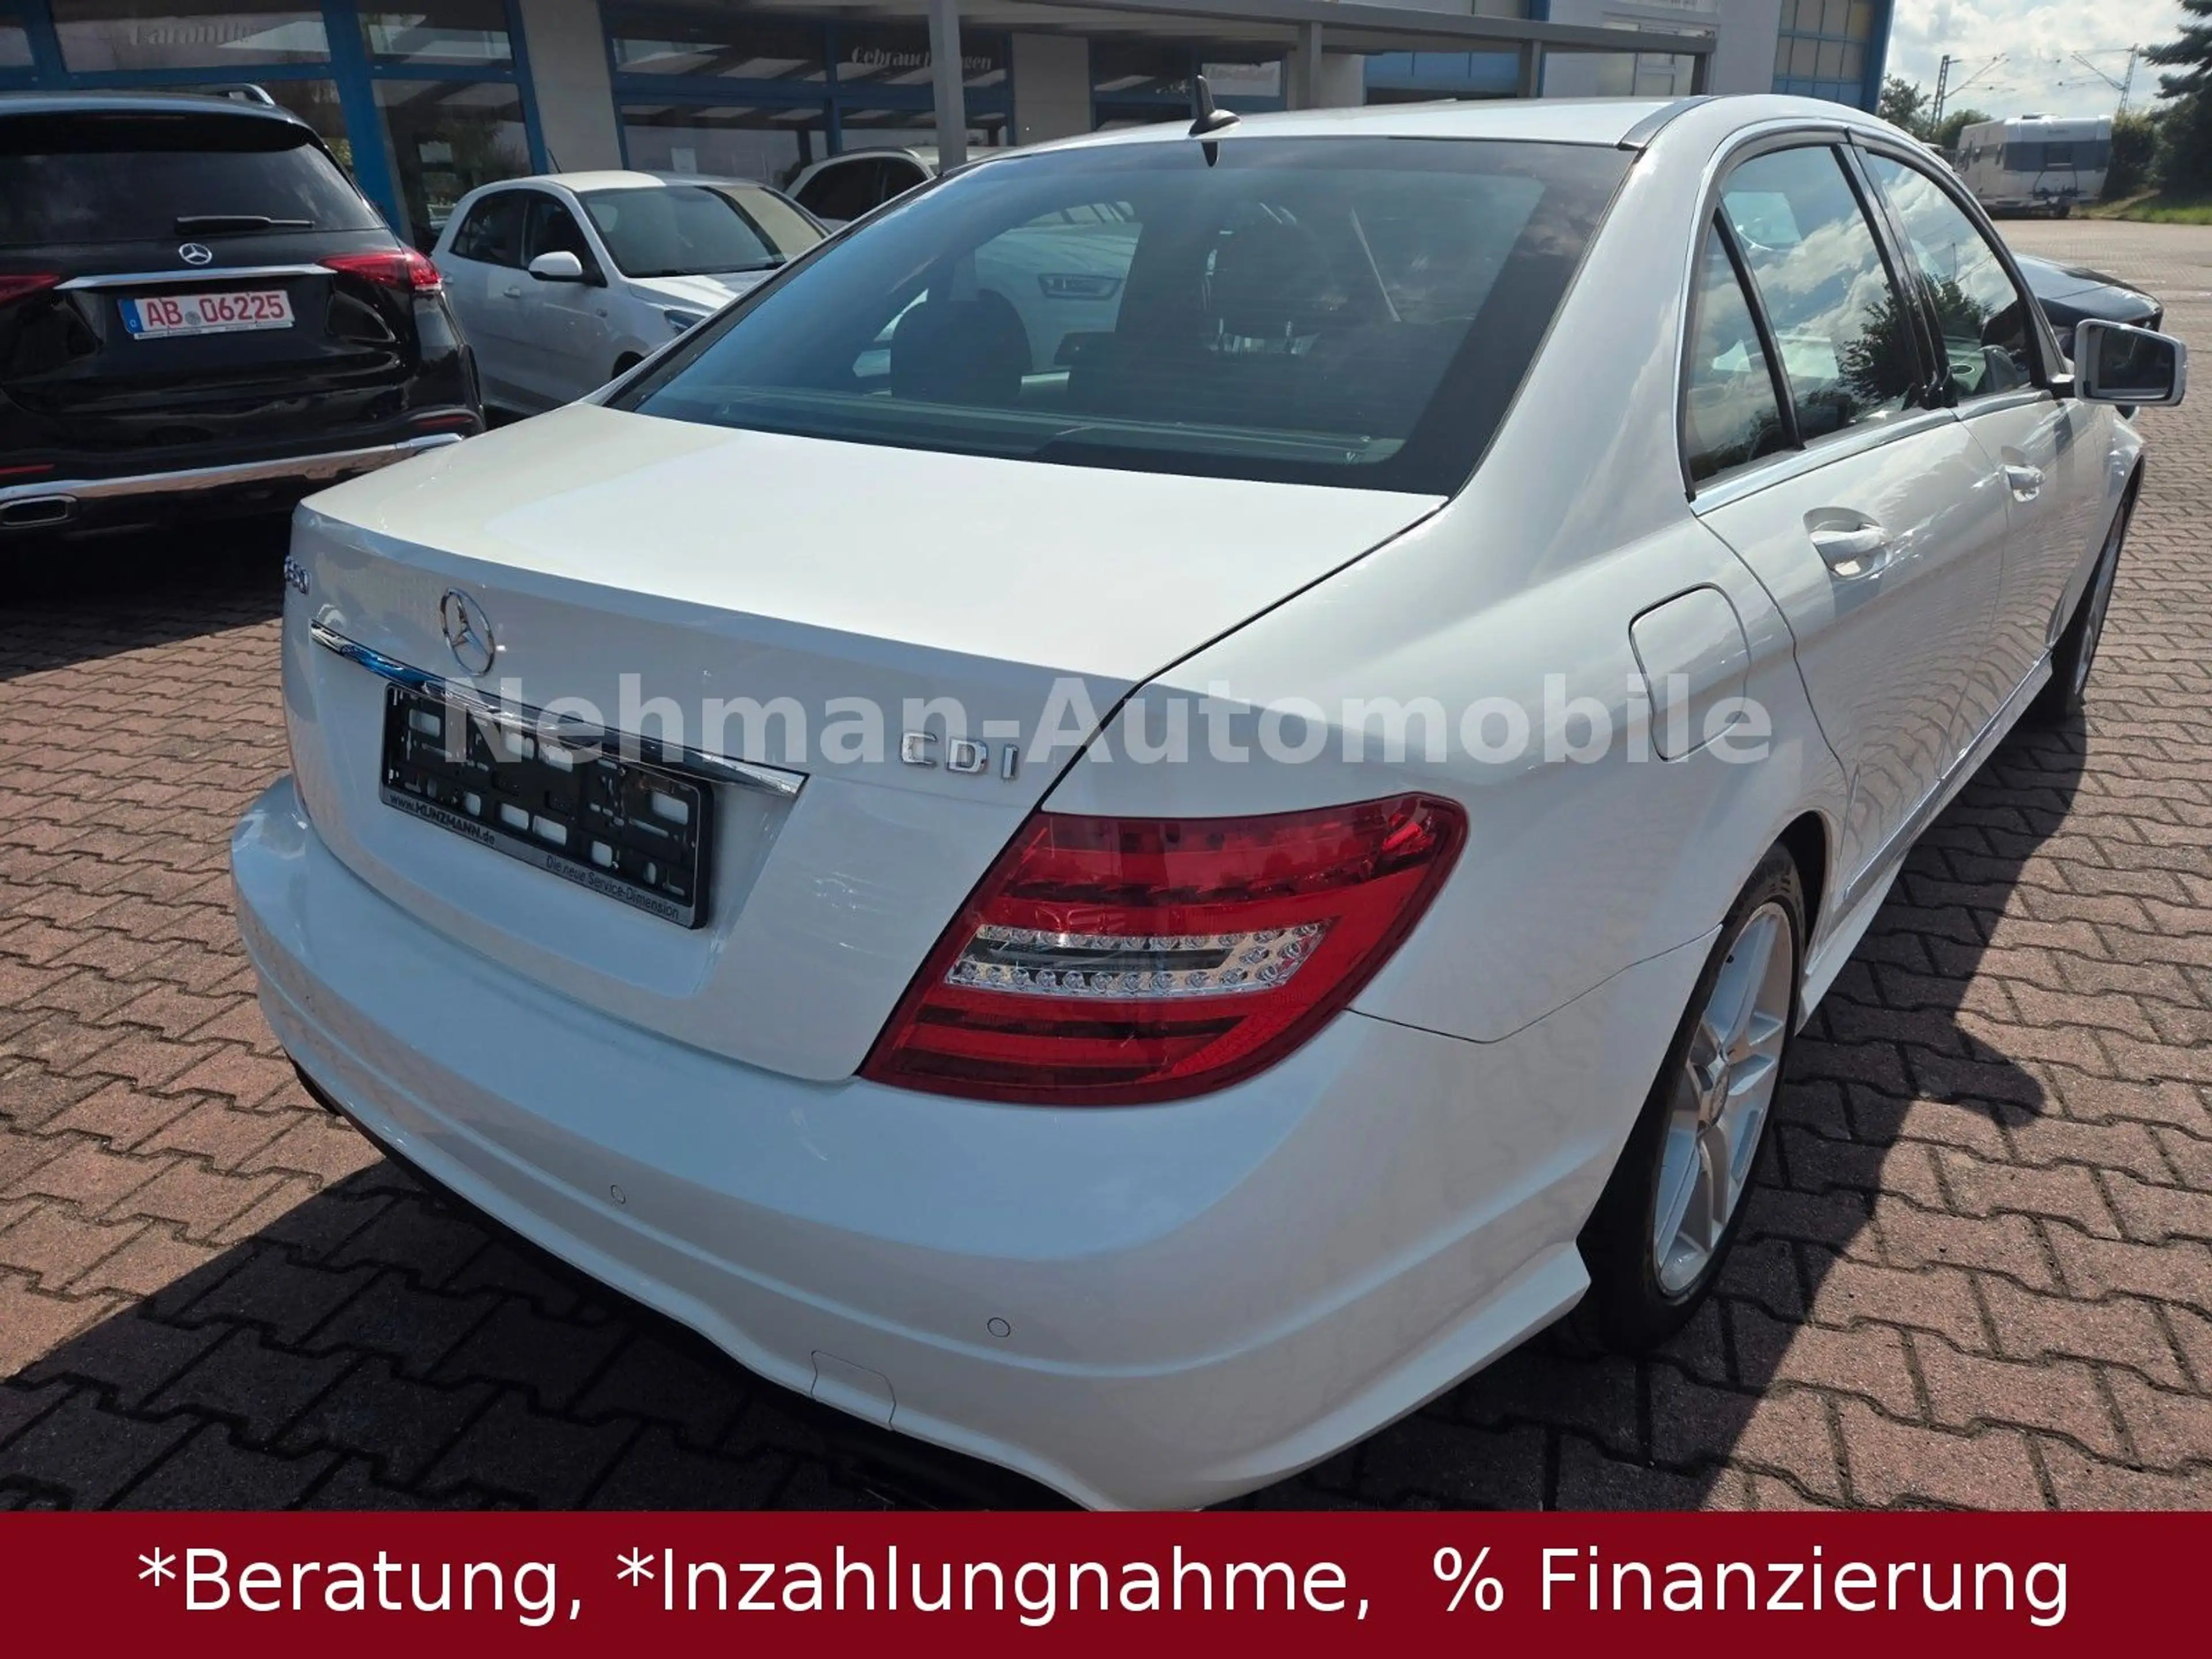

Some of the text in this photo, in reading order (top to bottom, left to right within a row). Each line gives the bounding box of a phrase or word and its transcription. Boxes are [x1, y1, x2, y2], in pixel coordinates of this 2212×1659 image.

[146, 294, 285, 327] AB 06225
[900, 730, 1019, 780] CDI
[546, 855, 680, 919] Die neue Service-Dimension
